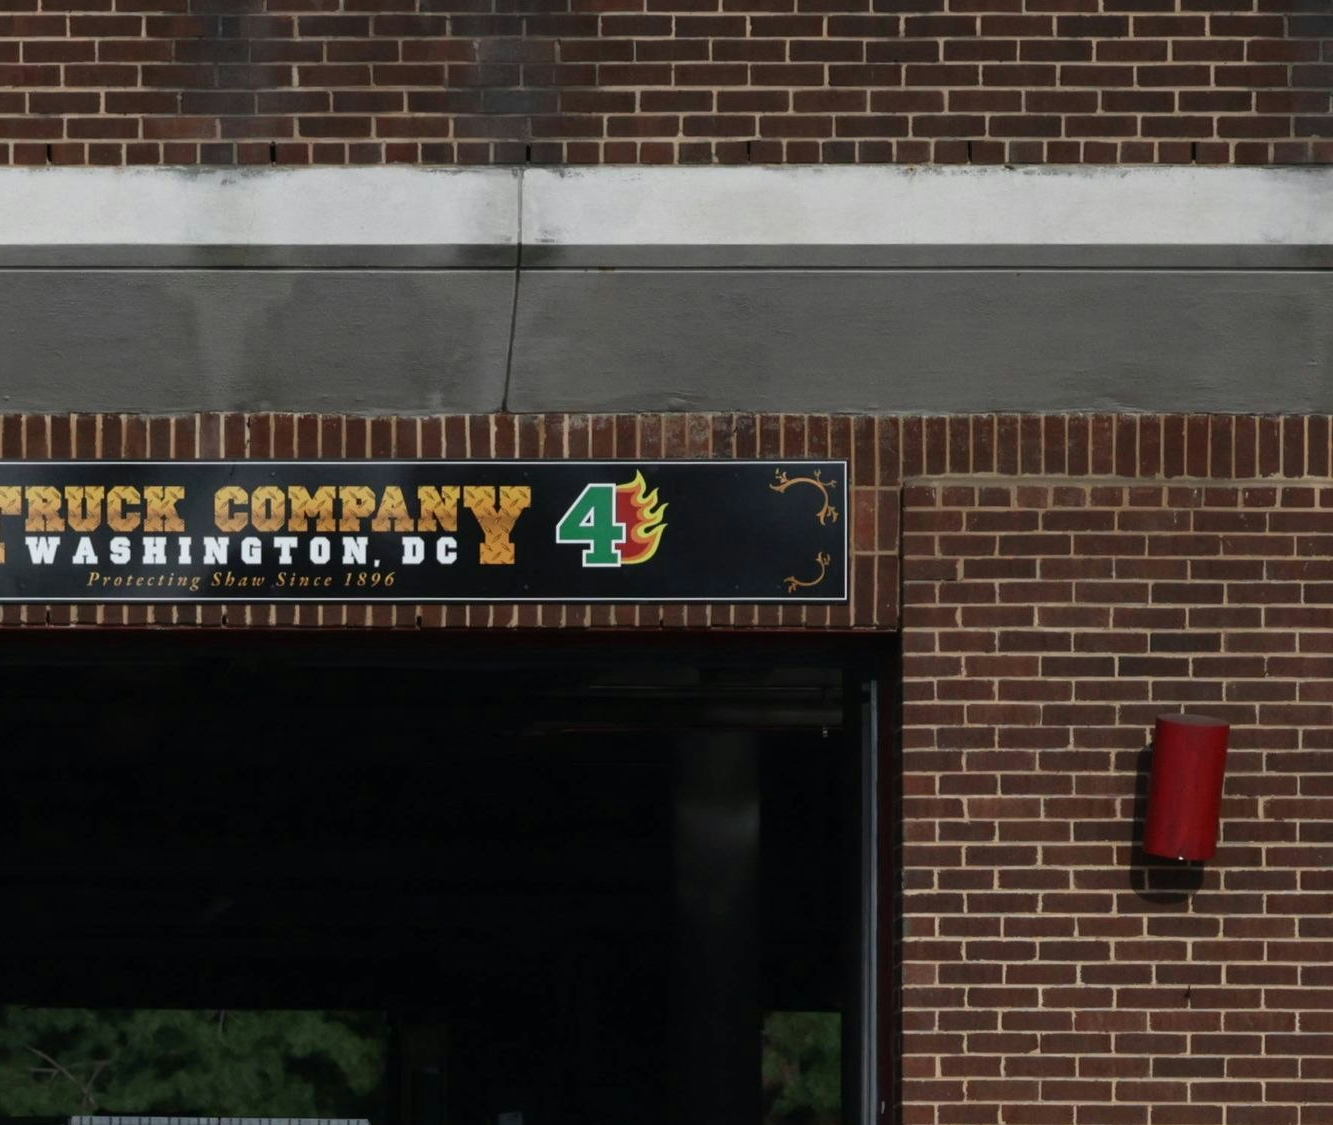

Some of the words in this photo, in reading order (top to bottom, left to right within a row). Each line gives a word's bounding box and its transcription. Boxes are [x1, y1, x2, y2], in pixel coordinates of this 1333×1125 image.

[25, 536, 380, 568] WASHINGTON,
[402, 536, 458, 565] DC
[214, 485, 532, 565] COMPANY
[555, 483, 627, 568] 4
[87, 571, 201, 591] Protecting
[211, 571, 265, 587] Shaw
[276, 572, 333, 587] Since
[344, 572, 396, 587] 1896
